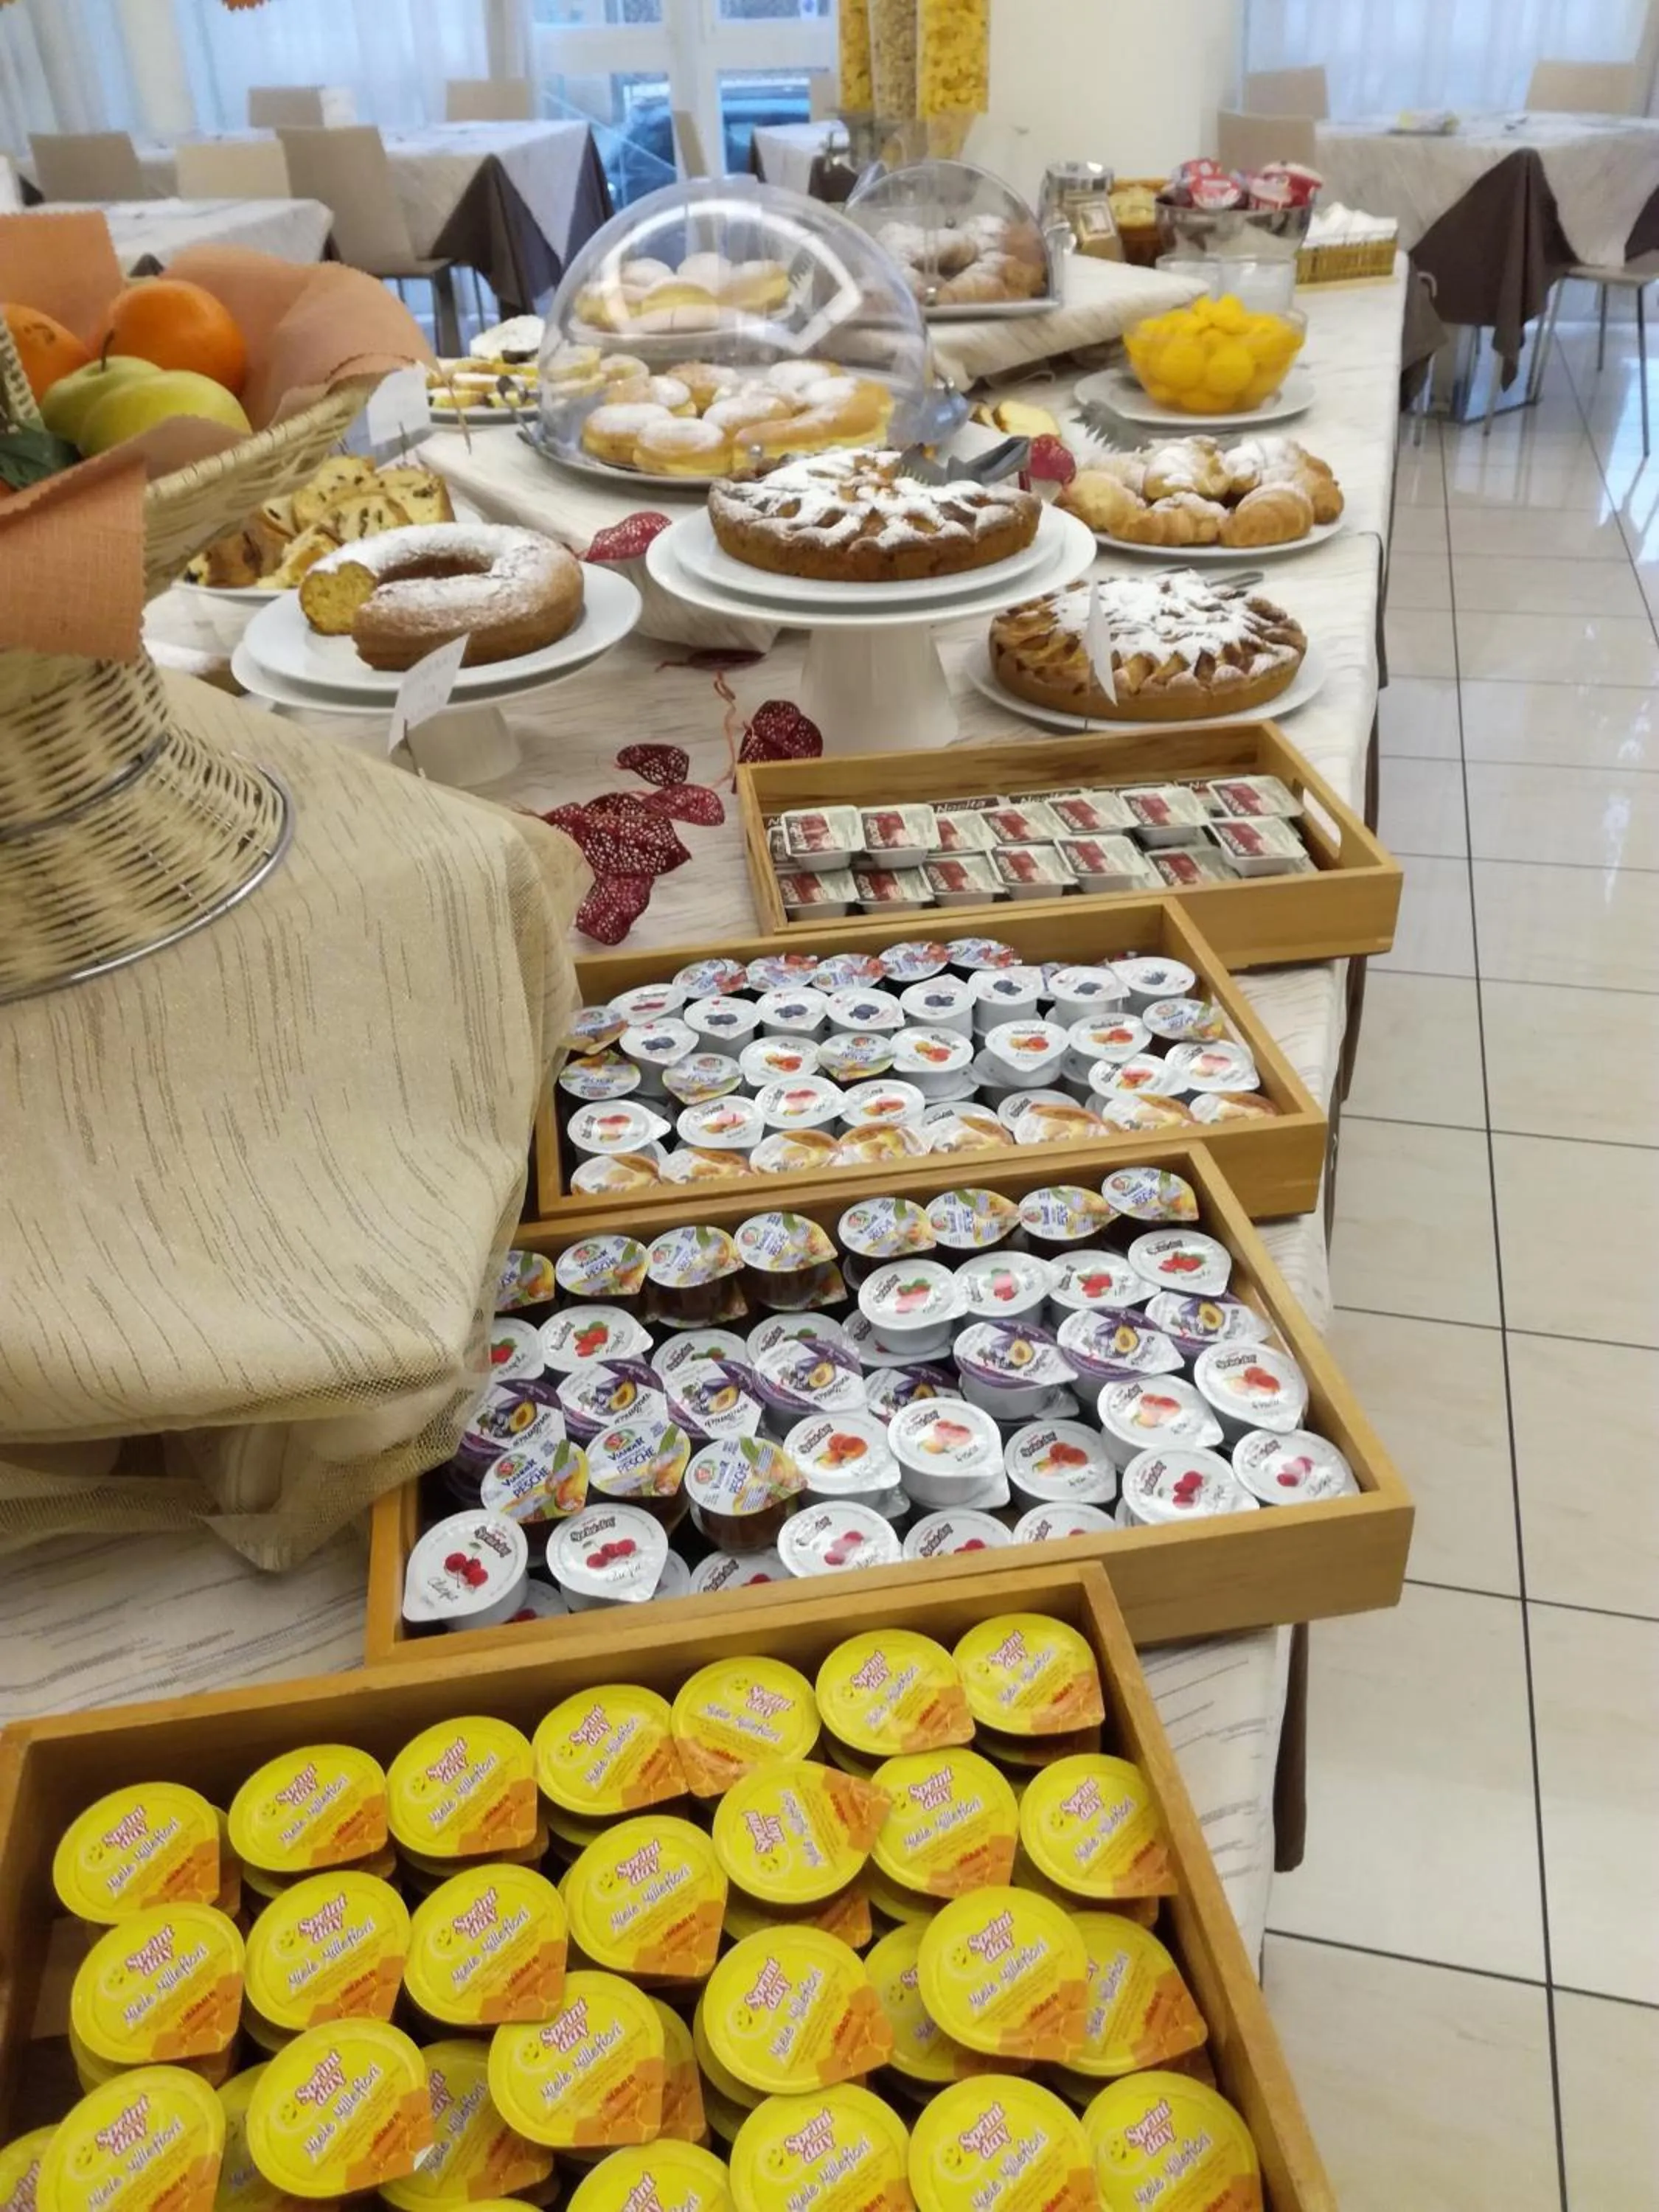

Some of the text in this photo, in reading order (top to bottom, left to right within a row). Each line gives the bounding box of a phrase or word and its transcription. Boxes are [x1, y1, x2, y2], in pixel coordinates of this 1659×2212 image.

[617, 1447, 655, 1475] PESCHE
[513, 1466, 550, 1498] PESCHE
[990, 1630, 1024, 1666] Sprint
[852, 1650, 886, 1688] Sprint
[570, 1705, 603, 1745] Sprint
[590, 1719, 612, 1747] day
[427, 1736, 468, 1781] Sprint
[443, 1756, 468, 1784] day
[276, 1763, 316, 1805] Sprint
[293, 1778, 318, 1806] day
[908, 1766, 953, 1804] Sprint
[922, 1783, 953, 1812] day
[1061, 1777, 1099, 1816] Sprint
[1079, 1793, 1104, 1821] day
[102, 1805, 147, 1848] Sprint
[119, 1823, 148, 1851] day
[617, 1840, 661, 1879] Sprint
[629, 1856, 660, 1885] day
[298, 1893, 347, 1937] Sprint
[453, 1887, 497, 1933] Sprint
[469, 1910, 498, 1939] day
[125, 1924, 175, 1972] Sprint
[312, 1916, 344, 1944] day
[968, 1910, 1013, 1955] Sprint
[984, 1933, 1014, 1962] day
[140, 1945, 173, 1977] day
[745, 1957, 780, 2010] Sprint
[767, 1975, 791, 2011] day
[540, 1996, 588, 2048] Sprint
[558, 2020, 589, 2053] day
[296, 2049, 342, 2104] Sprint
[315, 2068, 346, 2106] day
[96, 2094, 150, 2149] Sprint
[113, 2118, 148, 2156] day
[785, 2107, 833, 2154] Sprint
[959, 2101, 1006, 2154] Sprint
[1124, 2098, 1171, 2146] Sprint
[1144, 2119, 1176, 2157] day
[801, 2130, 835, 2163] day
[980, 2124, 1012, 2159] day
